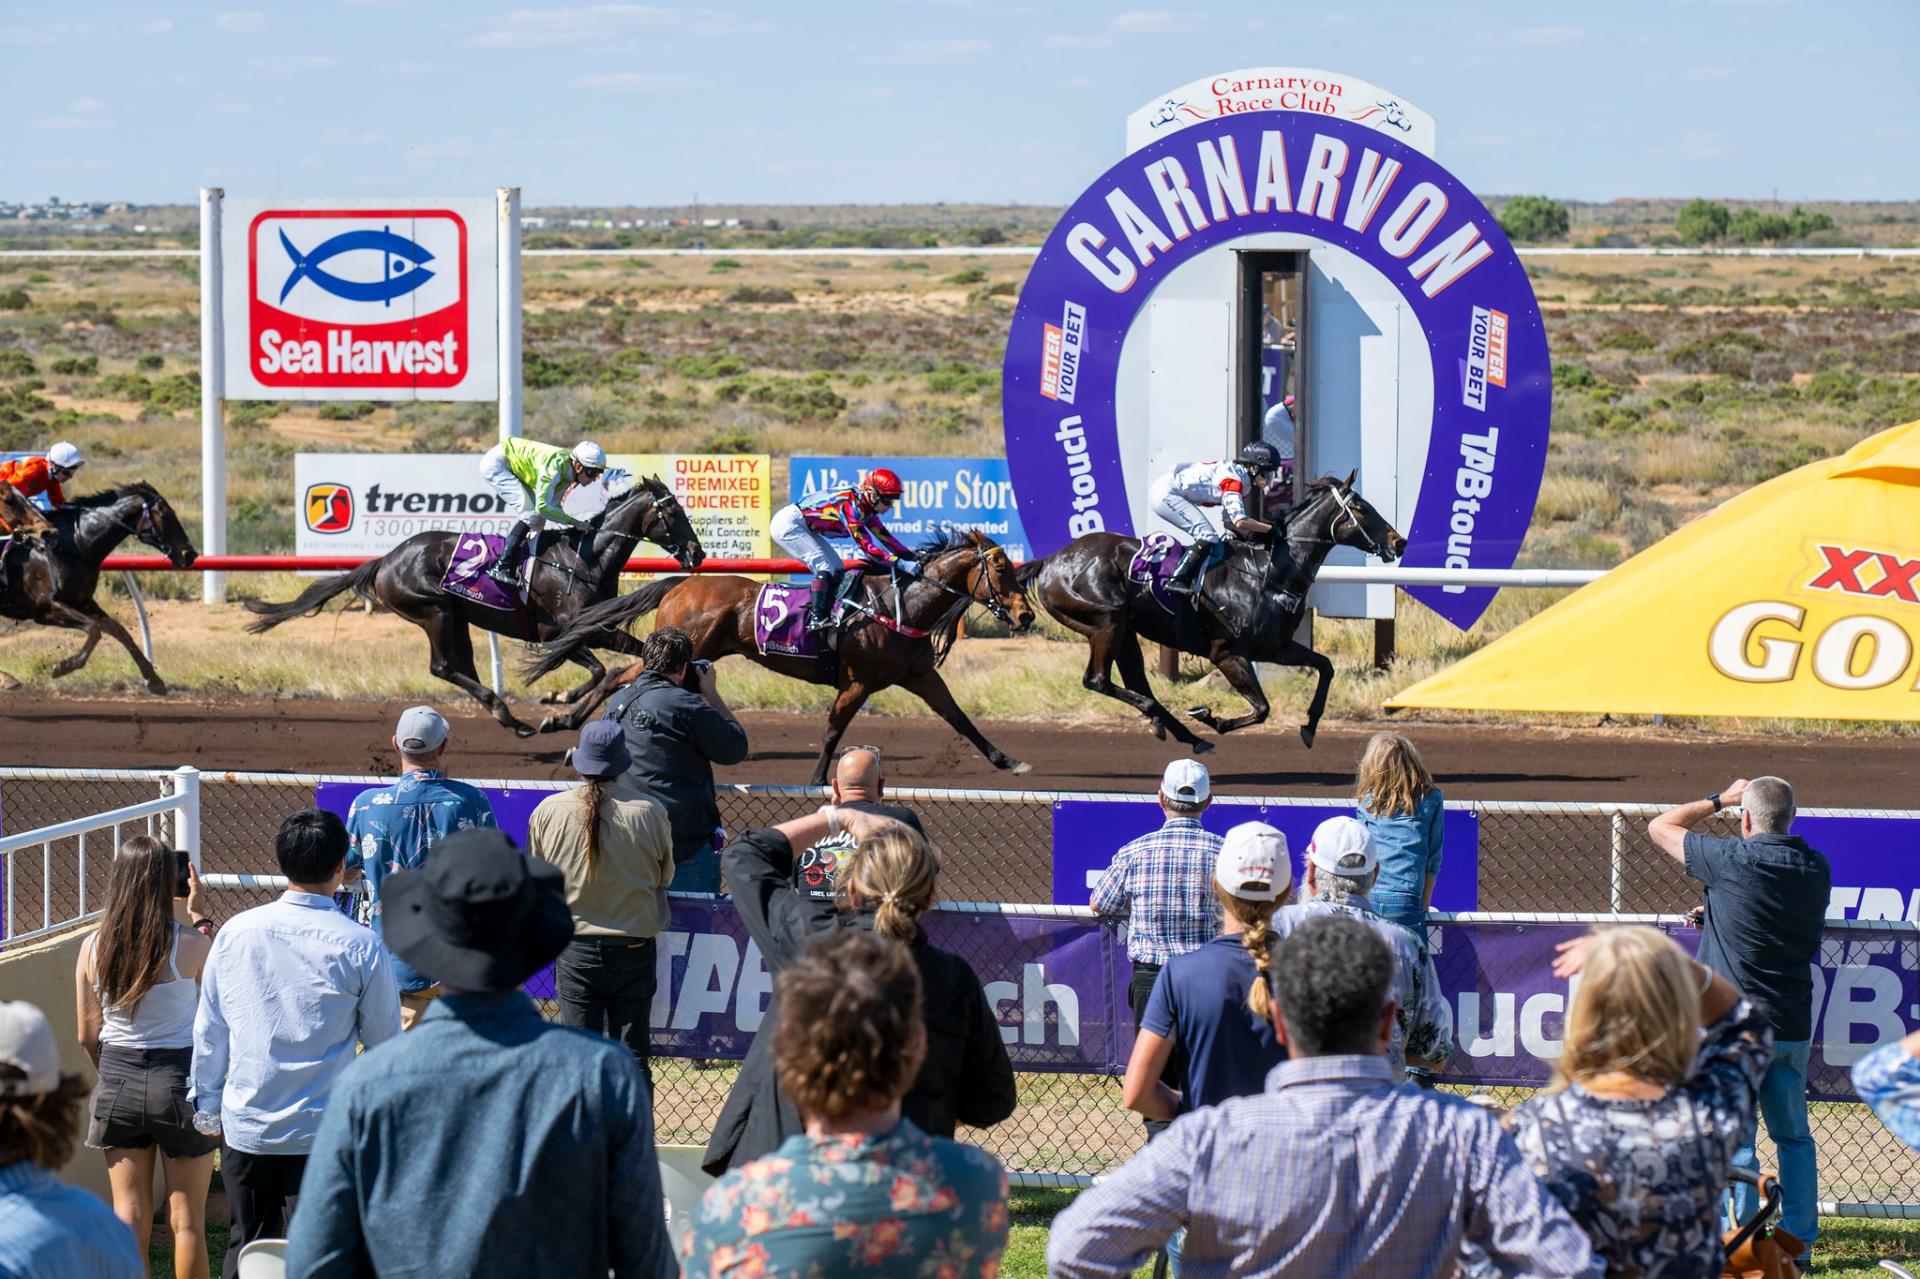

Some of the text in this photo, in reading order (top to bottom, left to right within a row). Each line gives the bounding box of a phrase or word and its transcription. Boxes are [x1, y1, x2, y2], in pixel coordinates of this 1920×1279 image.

[1211, 76, 1343, 96] Carnarvon
[1216, 91, 1336, 116] Race Club
[1065, 129, 1494, 300] CARNARVON
[259, 328, 459, 375] Sea Harvest
[1043, 331, 1062, 395] BETTER
[1060, 307, 1082, 397] YOUR BET
[1467, 314, 1488, 404] YOUR BET
[1487, 313, 1506, 380] BETTER
[676, 460, 759, 473] QUALITY
[676, 477, 760, 491] PREMIXED
[1055, 414, 1105, 539] Btouch
[365, 482, 509, 514] tremor
[1442, 427, 1499, 594] TABtouc
[362, 519, 511, 537] 1300TREMOR
[689, 515, 733, 525] Suppliers
[696, 527, 760, 537] Mix Concrete
[884, 520, 922, 534] wned
[456, 538, 489, 578] 2
[732, 540, 752, 551] Agg
[1808, 545, 1920, 604] XX
[760, 588, 790, 632] 5
[1706, 599, 1920, 693] GO
